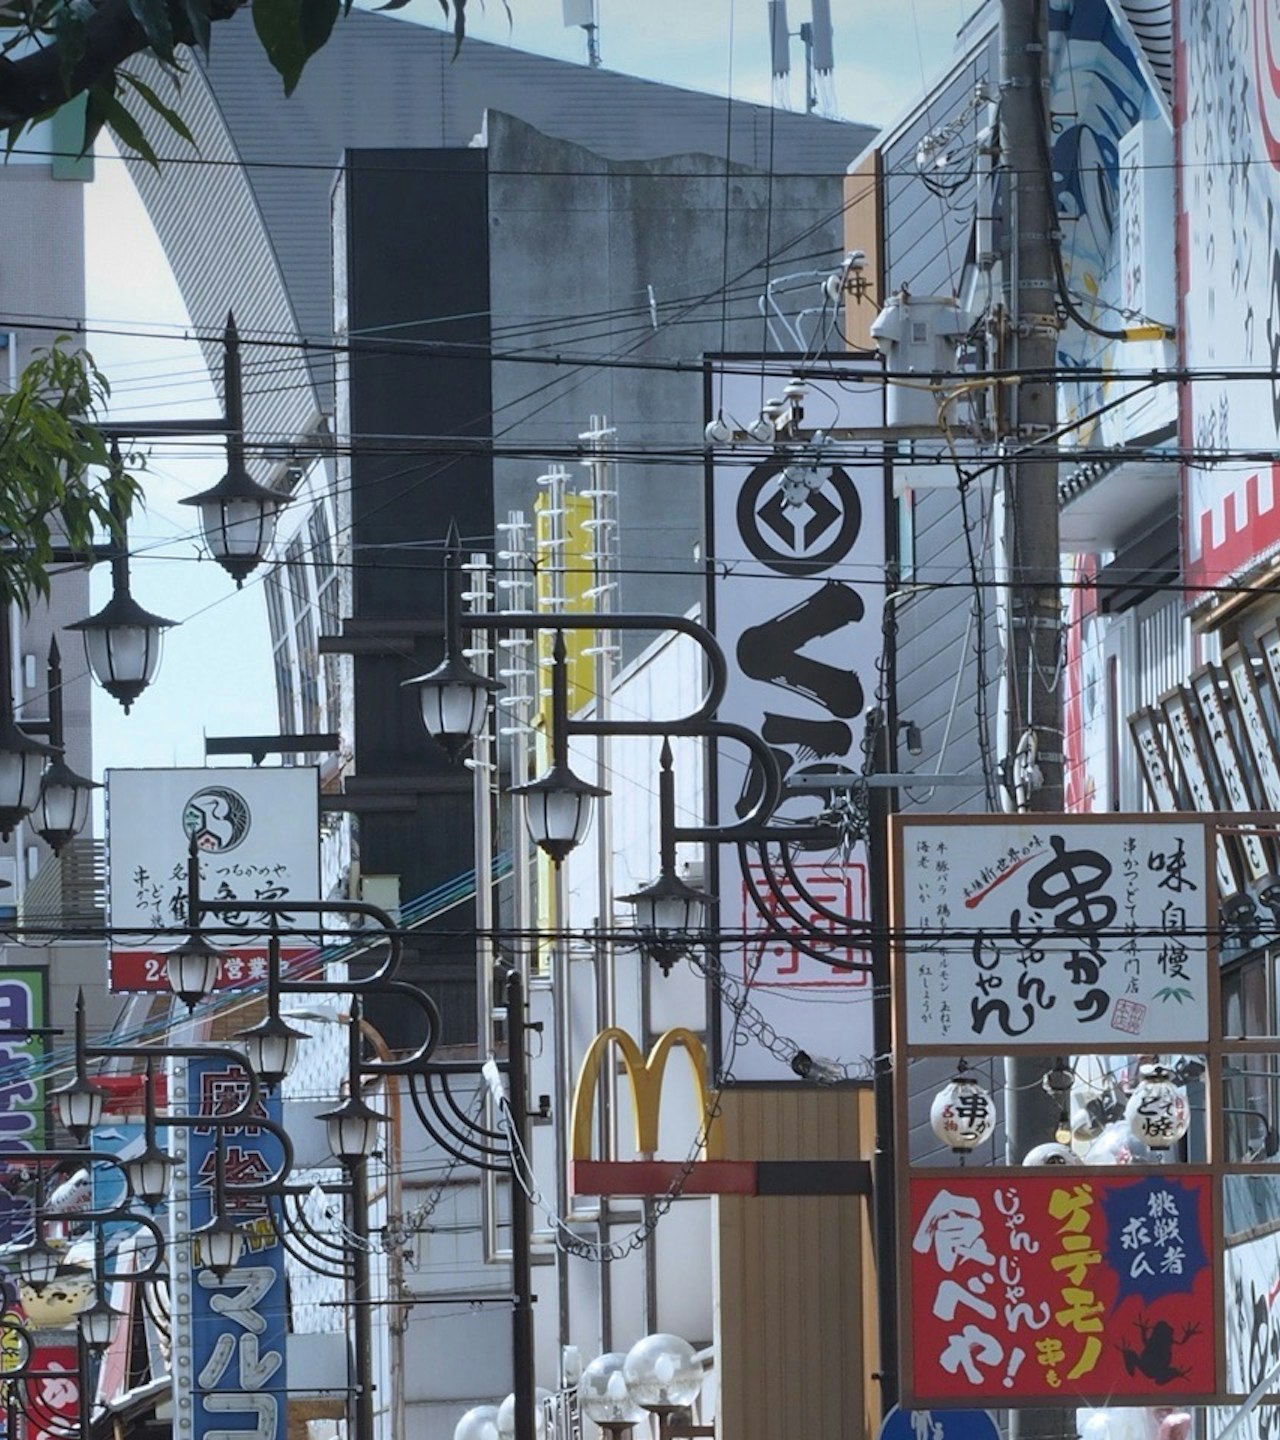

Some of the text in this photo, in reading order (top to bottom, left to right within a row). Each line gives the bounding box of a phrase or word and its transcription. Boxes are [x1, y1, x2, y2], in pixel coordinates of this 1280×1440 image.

[1027, 835, 1118, 1023] 串かつ
[1148, 837, 1198, 982] 味自慢
[1048, 1183, 1105, 1381] ゲテモノ
[1120, 1217, 1156, 1280] 求ム
[1147, 1190, 1186, 1276] 挑戦者
